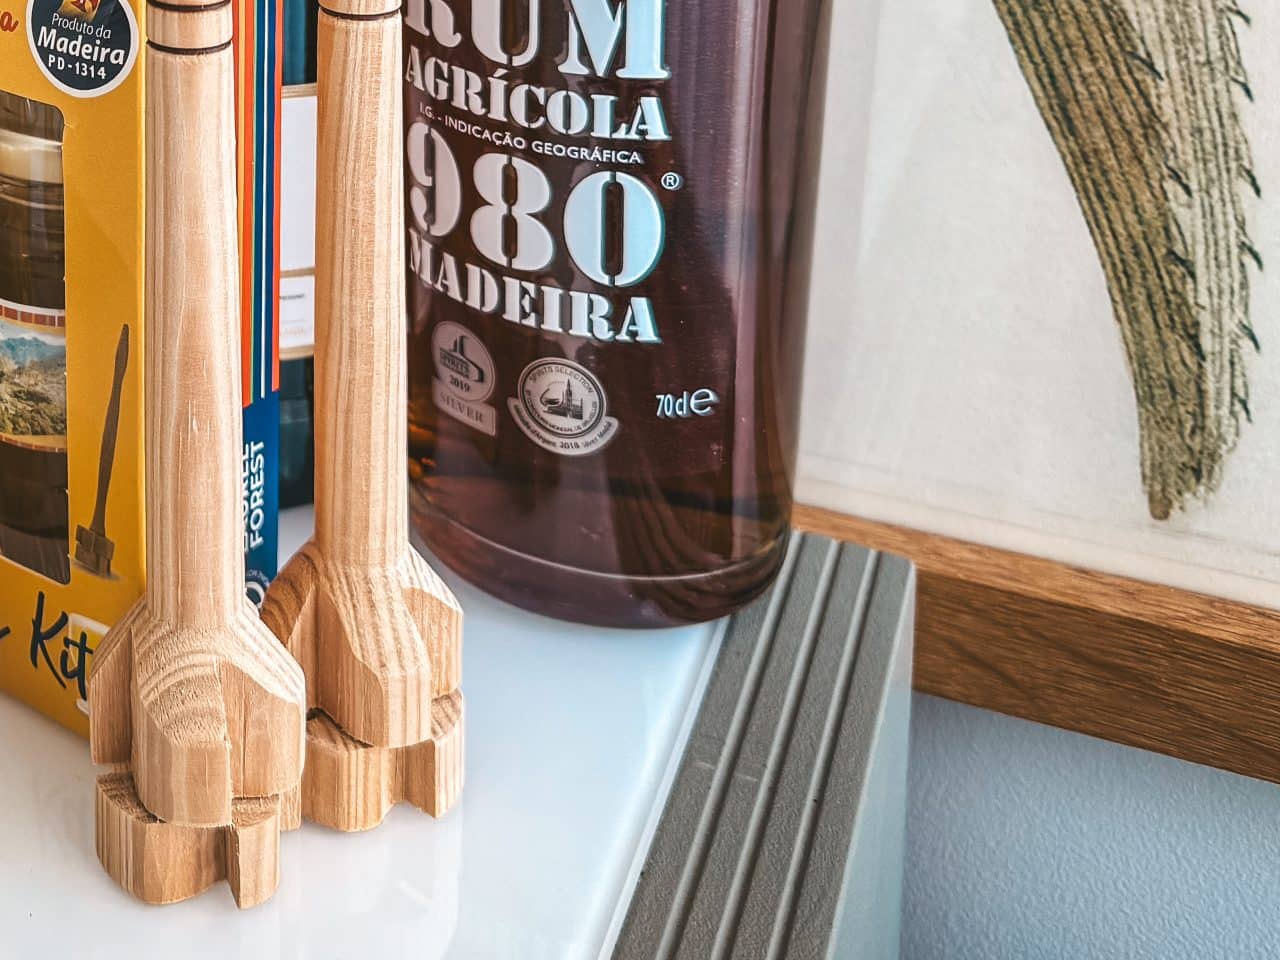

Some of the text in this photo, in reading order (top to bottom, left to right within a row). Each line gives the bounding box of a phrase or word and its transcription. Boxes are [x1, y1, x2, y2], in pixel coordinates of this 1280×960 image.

[37, 26, 126, 65] Madeira
[51, 12, 112, 40] Produto da
[405, 44, 670, 141] AGRÍCOLA
[444, 115, 526, 150] INDICAÇÃO
[531, 139, 642, 165] GEOGRÁFICA
[407, 122, 666, 288] 980
[408, 228, 662, 344] MADEIRA
[440, 391, 483, 423] SILVER
[555, 365, 595, 393] SELECTION
[250, 441, 264, 551] FOREST
[30, 591, 94, 701] Kit
